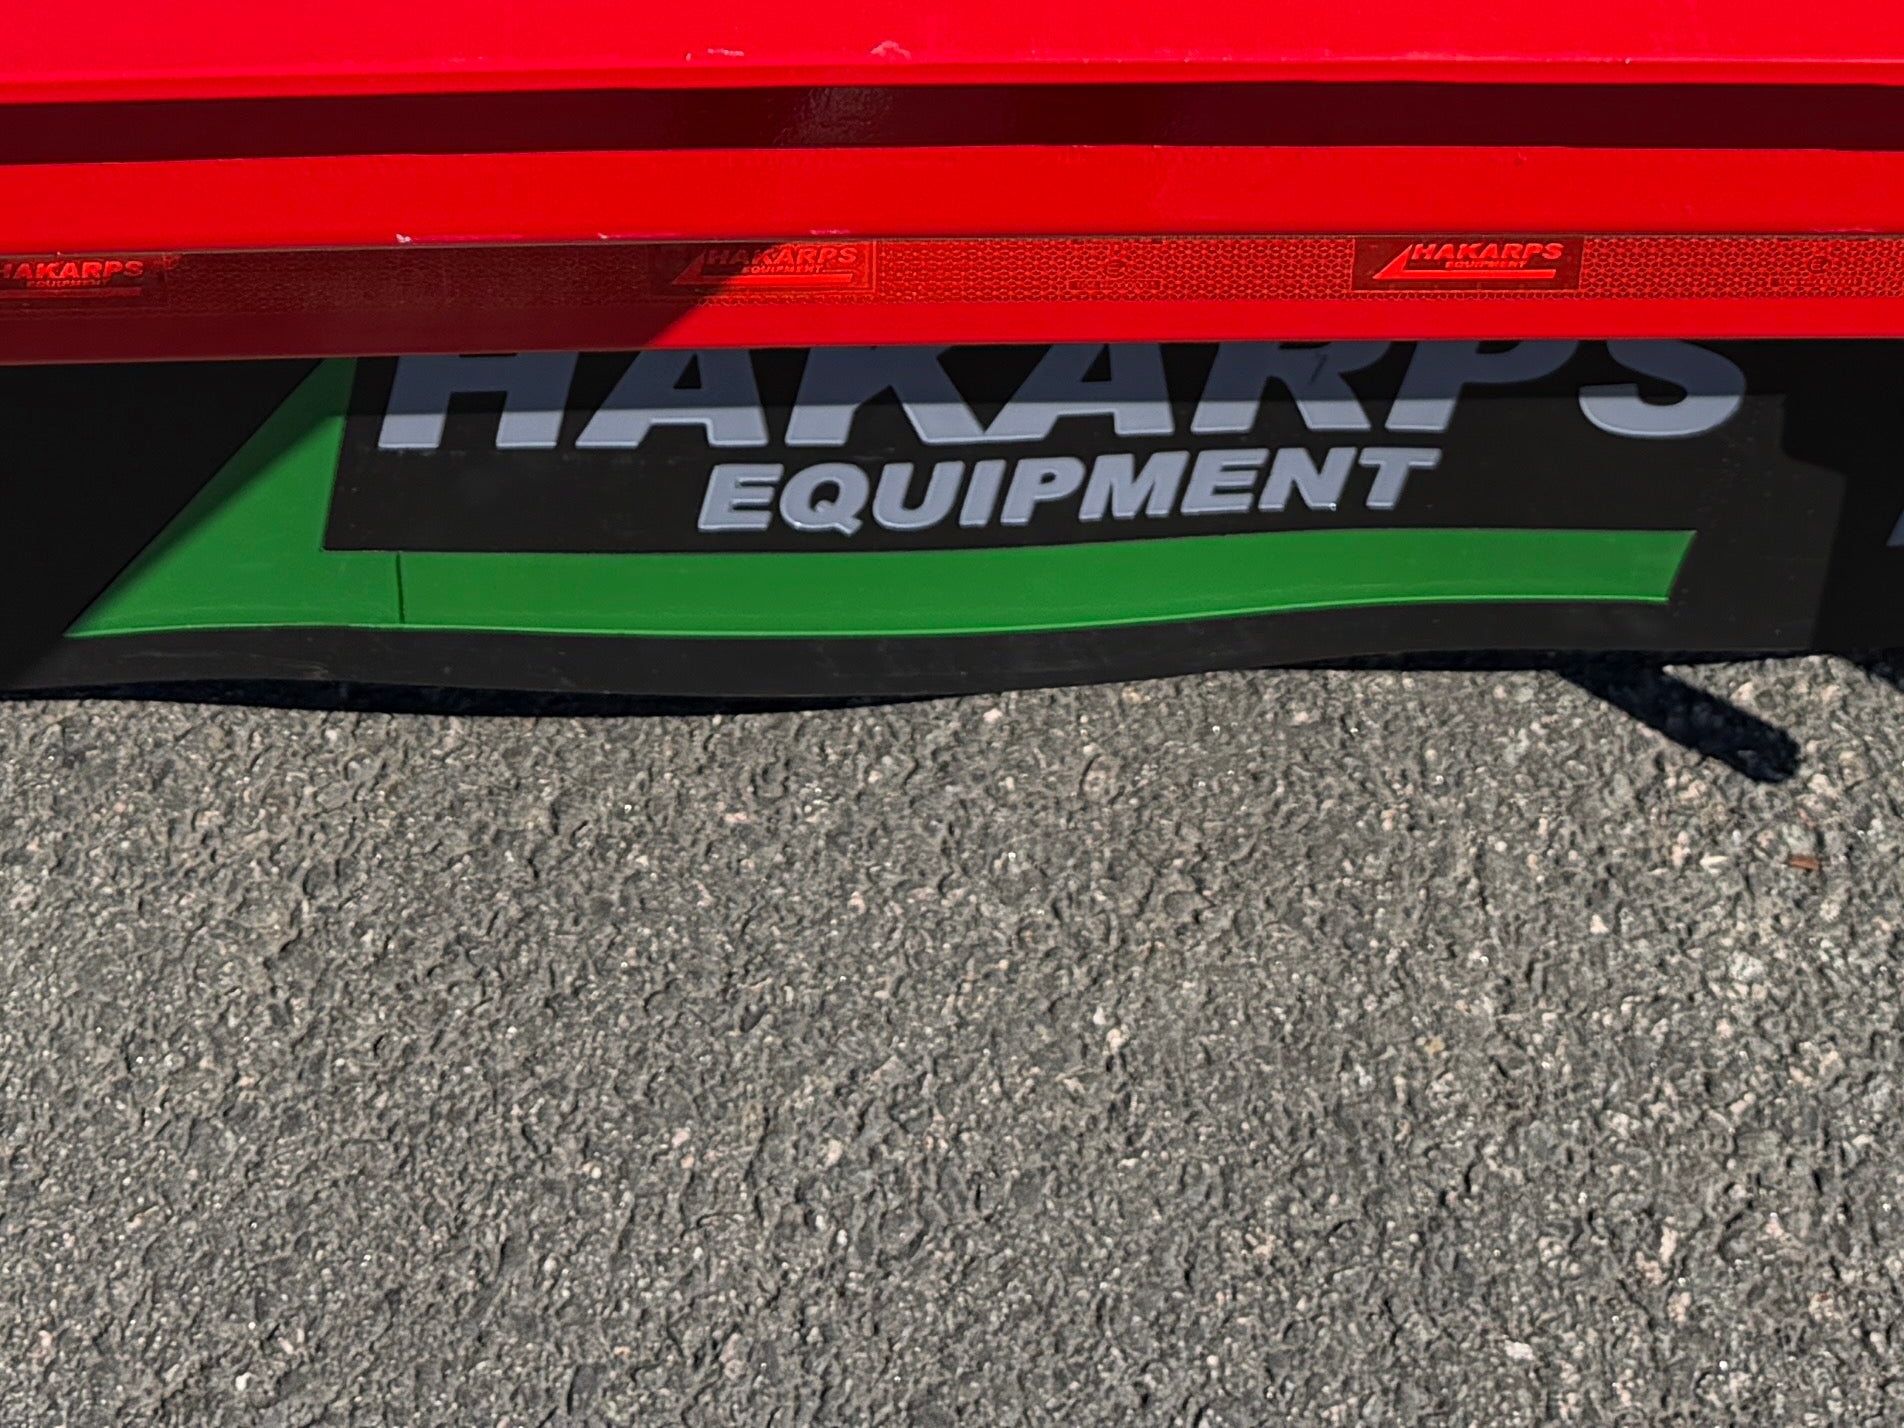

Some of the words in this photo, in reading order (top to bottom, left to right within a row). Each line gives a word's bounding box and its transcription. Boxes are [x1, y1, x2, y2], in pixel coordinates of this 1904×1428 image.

[706, 246, 858, 265] HAKARPS
[1411, 242, 1565, 260] HAKARPS
[377, 340, 1747, 450] HAKARPS
[697, 446, 1443, 537] EQUIPMENT
